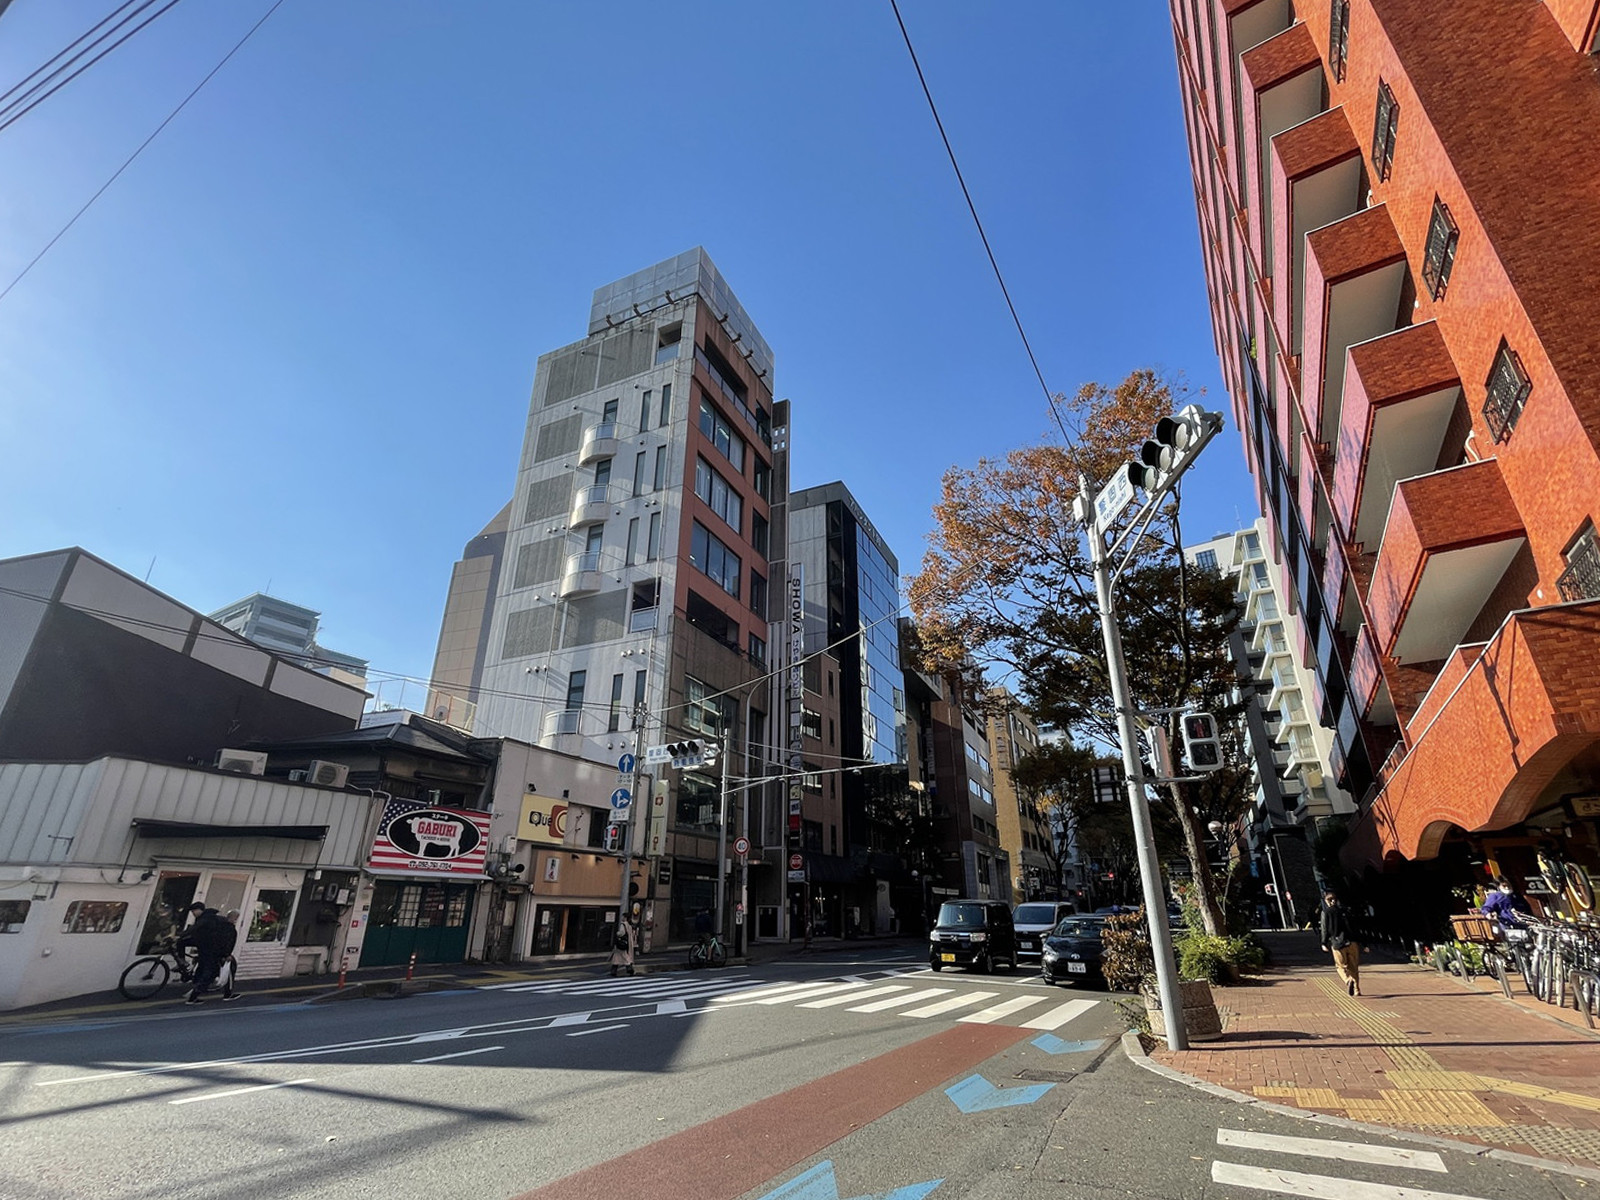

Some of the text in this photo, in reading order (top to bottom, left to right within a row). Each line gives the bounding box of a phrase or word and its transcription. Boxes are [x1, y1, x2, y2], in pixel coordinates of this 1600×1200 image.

[792, 578, 801, 634] SHOWA
[417, 821, 457, 838] GABURI
[737, 842, 746, 850] 40
